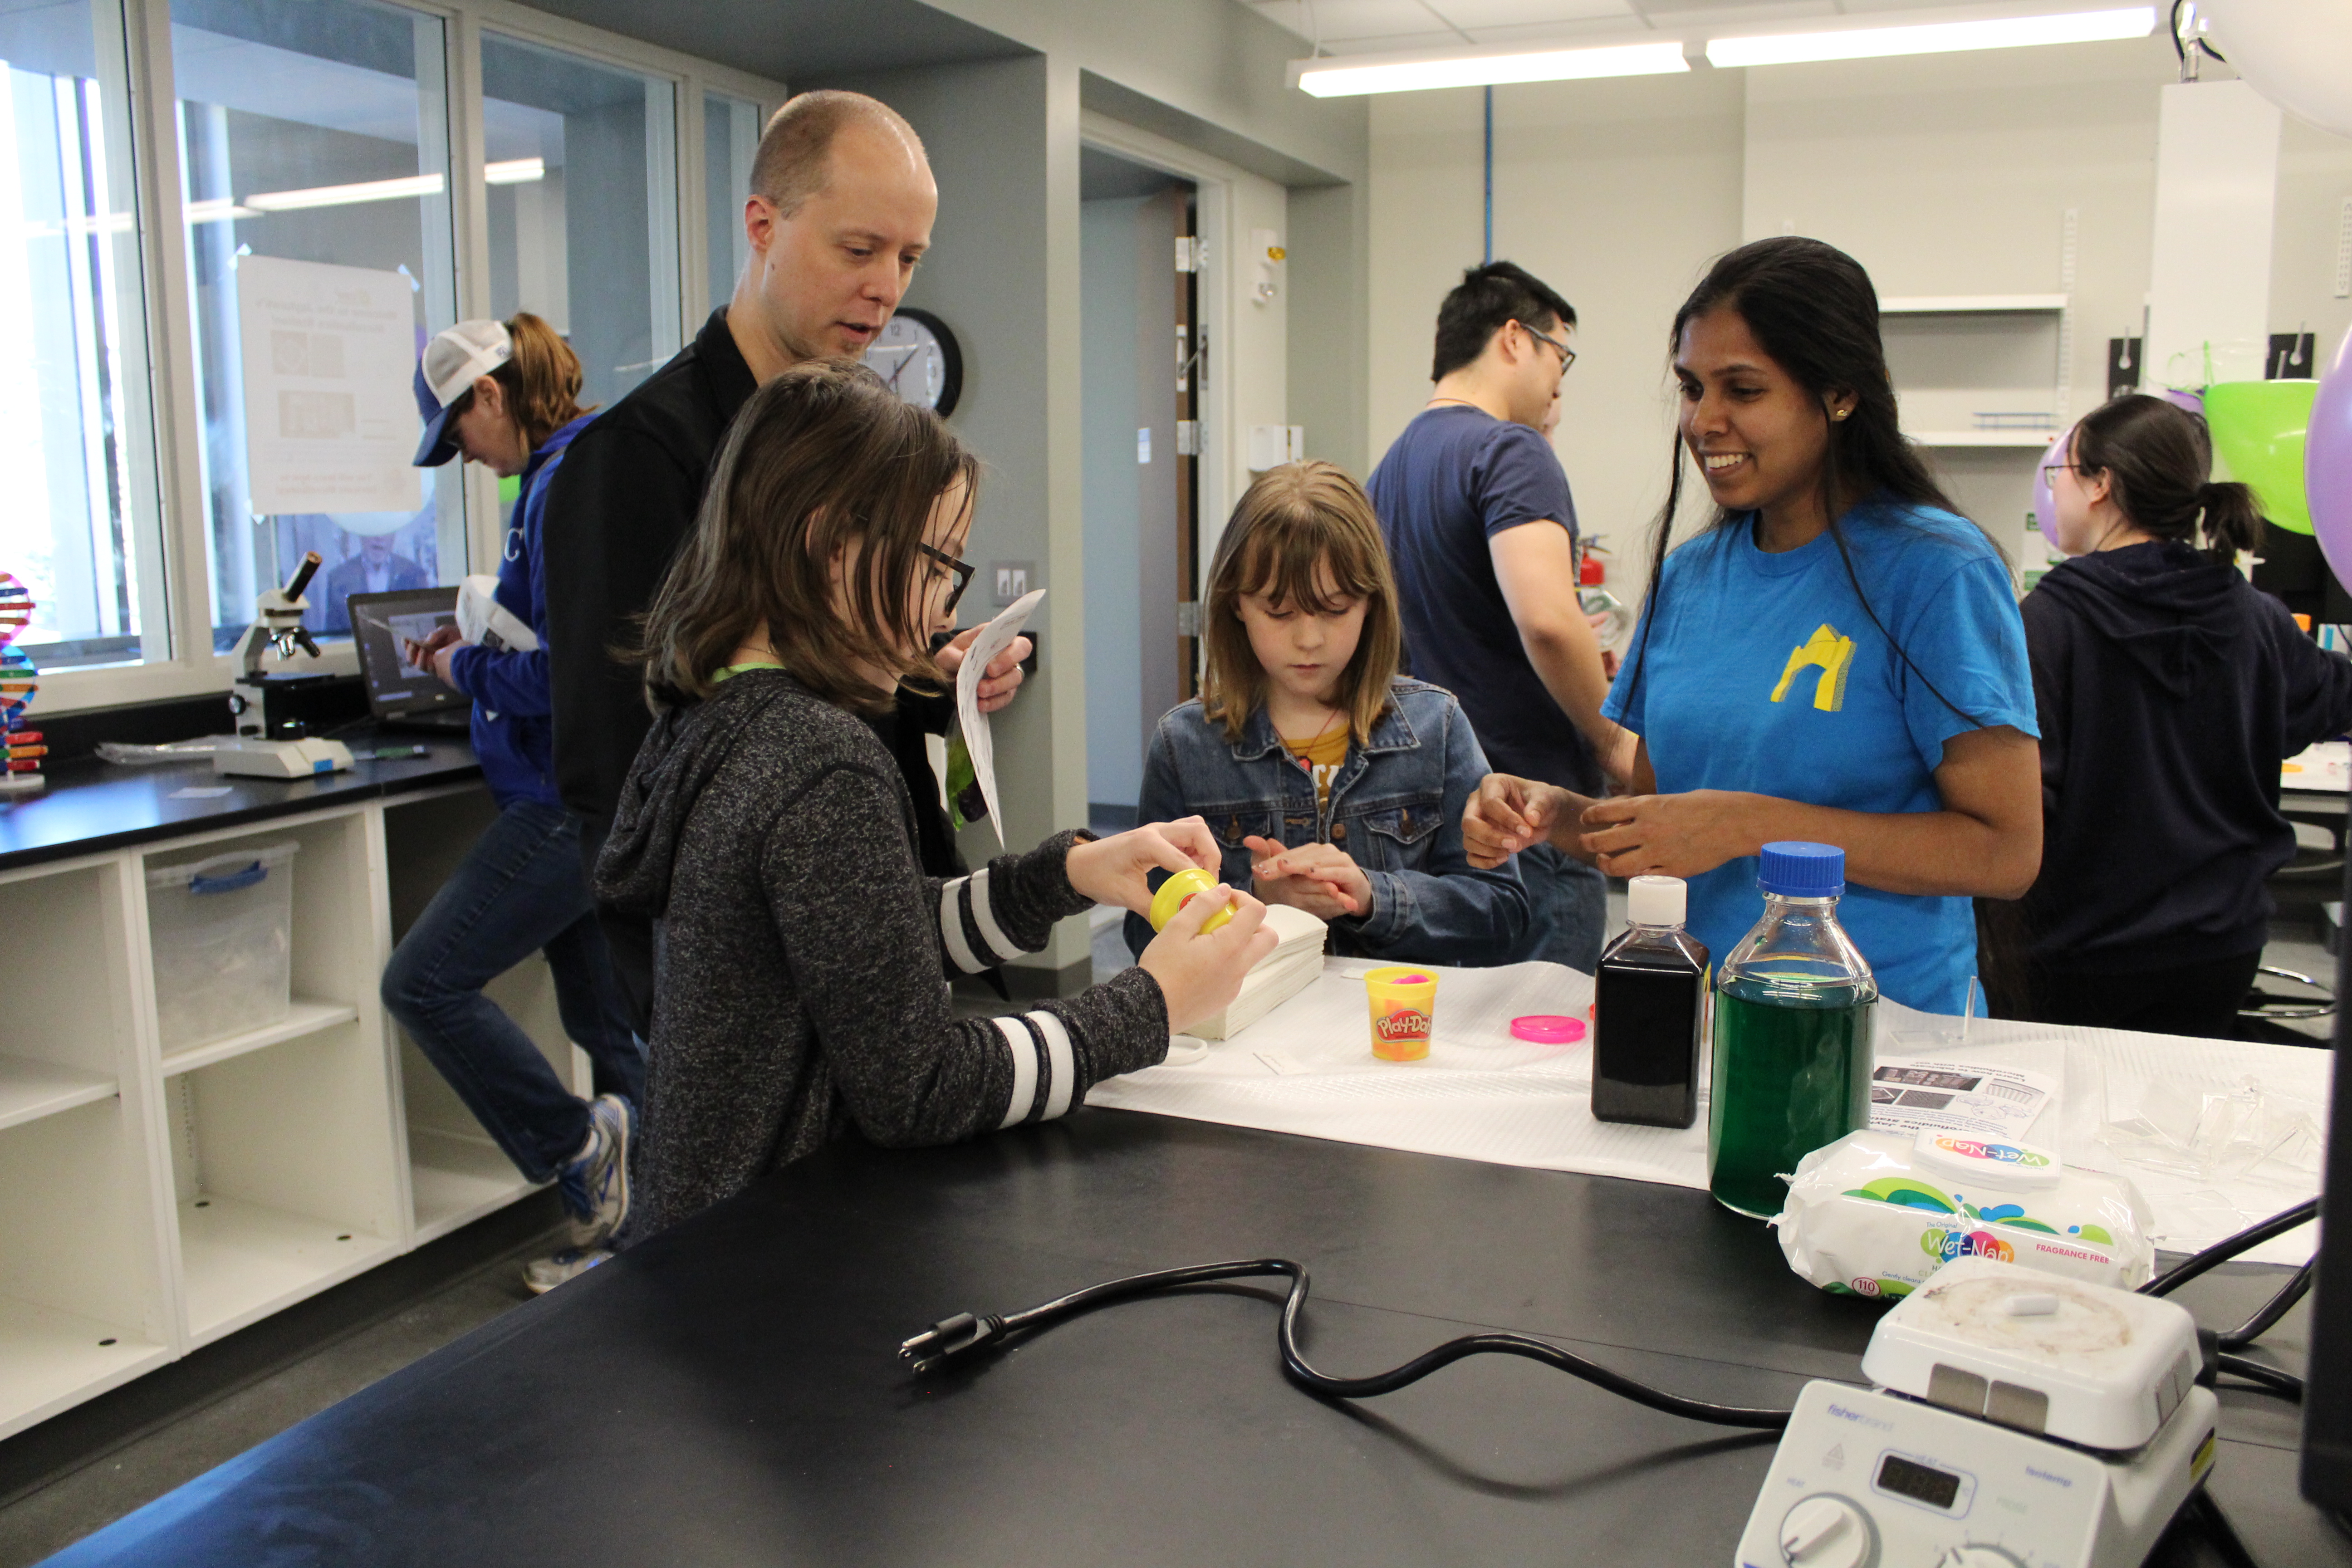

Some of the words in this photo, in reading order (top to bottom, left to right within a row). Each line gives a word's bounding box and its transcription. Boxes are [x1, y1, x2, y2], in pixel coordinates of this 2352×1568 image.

[926, 346, 933, 356] 2
[1377, 1015, 1431, 1038] Play-Doh
[1942, 1138, 2042, 1166] Wet-Nap
[2036, 1244, 2087, 1259] FRAGRANCE
[2089, 1254, 2110, 1264] FREE
[1858, 1279, 1875, 1292] 110
[1882, 1271, 1901, 1280] Gently
[1827, 1404, 1894, 1432] fisherbrand
[2025, 1465, 2073, 1488] Isotemp
